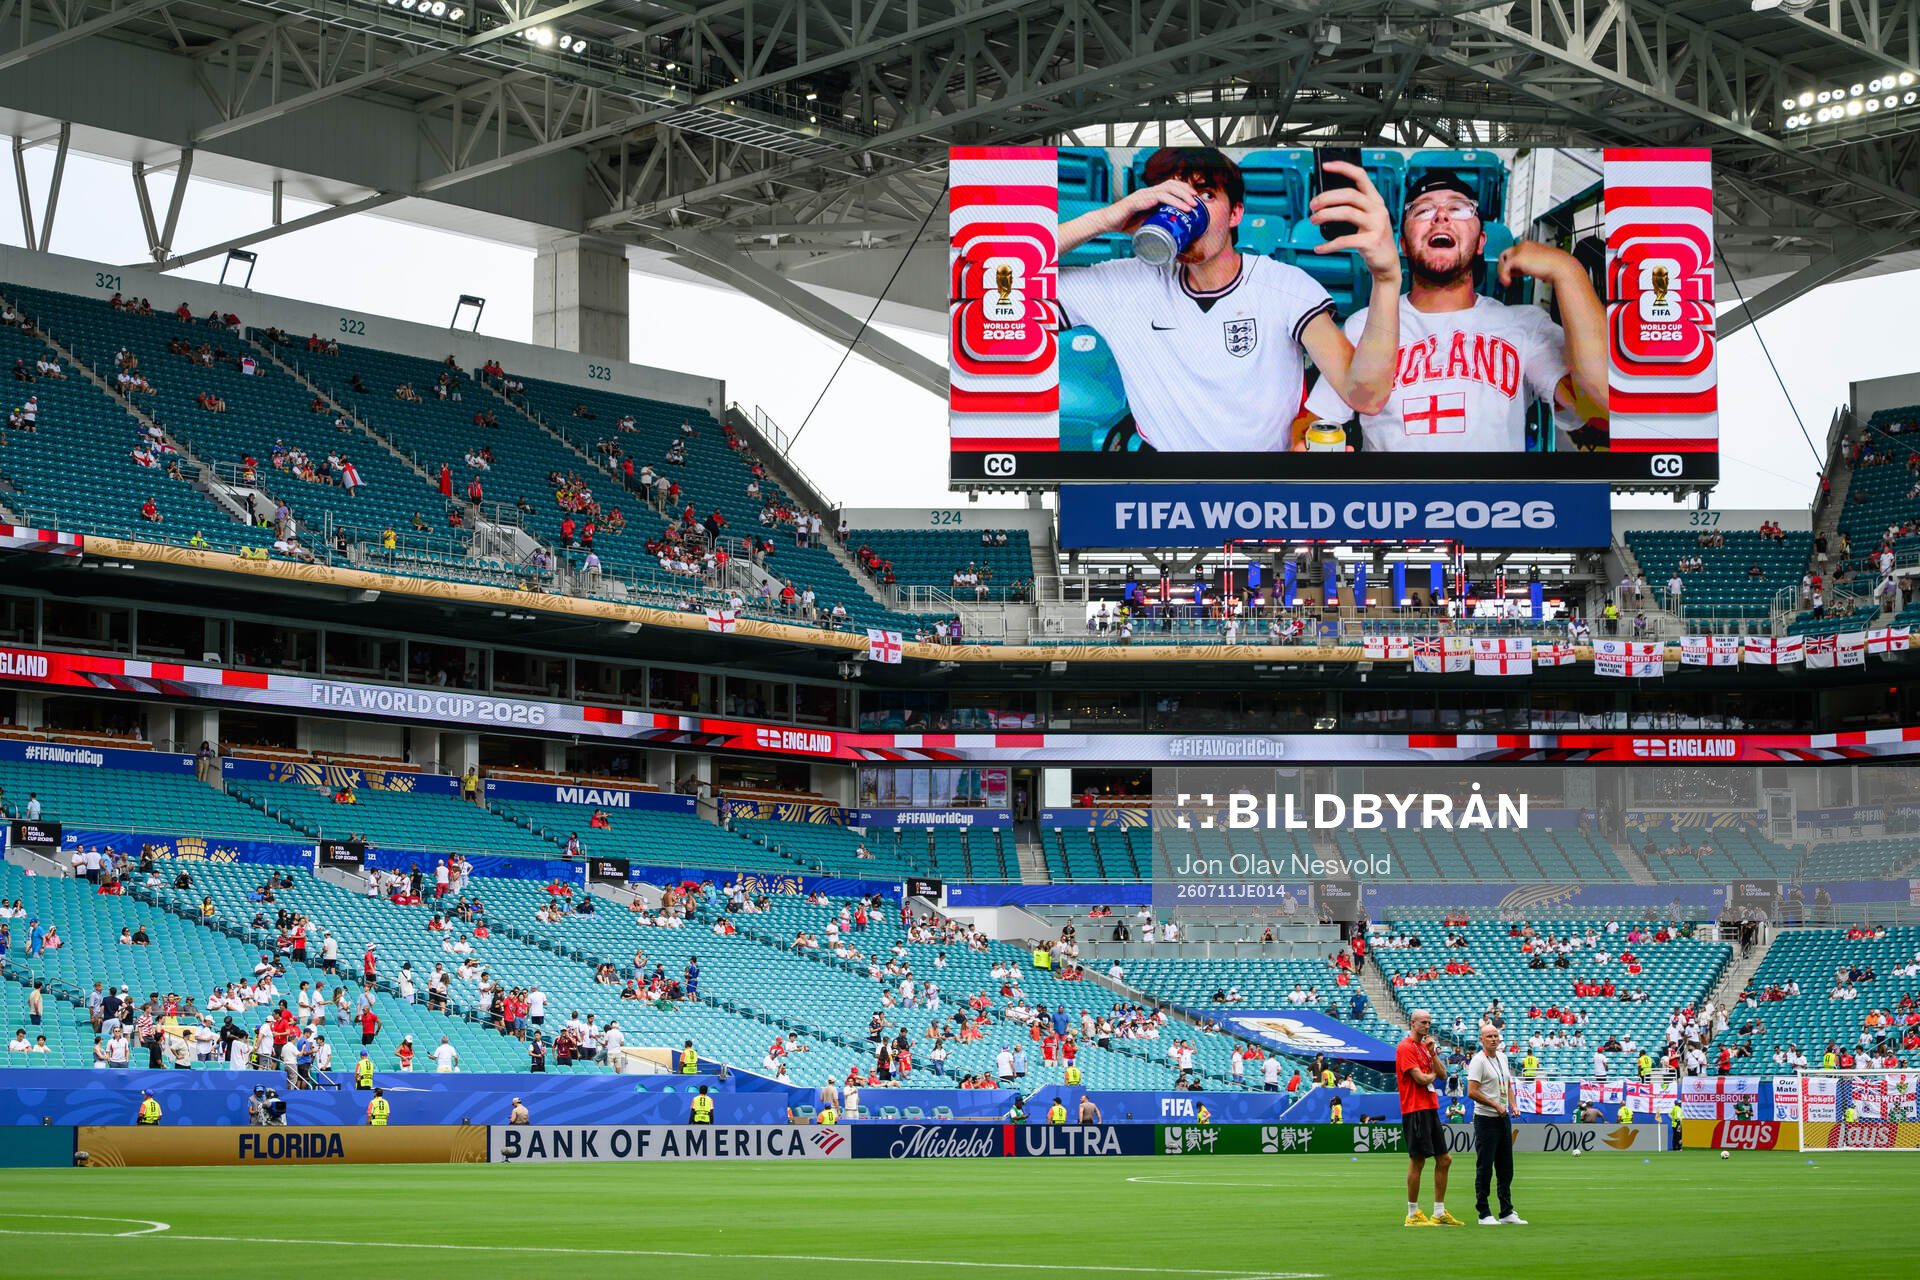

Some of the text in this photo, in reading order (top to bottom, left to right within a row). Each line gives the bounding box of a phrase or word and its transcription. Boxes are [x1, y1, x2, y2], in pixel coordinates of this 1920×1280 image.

[95, 272, 121, 291] 321
[995, 308, 1015, 316] FIFA
[1651, 309, 1671, 317] FIFA
[339, 317, 366, 336] 322
[983, 322, 1026, 330] WORLD CUP
[983, 330, 1026, 340] 2026
[1640, 323, 1683, 332] WORLD CUP
[1640, 331, 1683, 341] 2026
[588, 364, 612, 381] 323
[986, 457, 1014, 474] CC
[1653, 457, 1681, 474] CC
[930, 511, 962, 525] 324
[1115, 500, 1556, 530] FIFA WORLD CUP 2026
[1689, 511, 1721, 526] 327
[1596, 653, 1651, 662] PORTSMOUTH
[311, 683, 546, 725] FIFA WORLD CUP 2026
[782, 731, 832, 753] ENGLAND
[1169, 738, 1285, 758] #FIFAWorldCup
[1668, 738, 1736, 757] ENGLAND
[25, 745, 104, 768] #FIFAWorldCup
[224, 761, 234, 769] 221
[556, 786, 630, 808] MIAMI
[896, 812, 974, 827] #FIFAWorldCup
[66, 835, 78, 843] 120
[302, 849, 312, 858] 120
[367, 853, 377, 861] 121
[1161, 1098, 1195, 1117] FIFA
[1775, 1094, 1798, 1103] Jimm
[1861, 1094, 1907, 1103] NORWICH
[504, 1128, 806, 1158] BANK OF AMERICA
[890, 1124, 1122, 1159] Michelob ULTRA
[1185, 1126, 1219, 1154] 蒙牛
[1281, 1126, 1313, 1153] 蒙牛
[1372, 1126, 1402, 1153] 蒙牛
[1440, 1123, 1477, 1152] Dov
[1543, 1122, 1597, 1152] Dove
[1720, 1120, 1773, 1150] Lay's
[238, 1132, 344, 1159] FLORIDA
